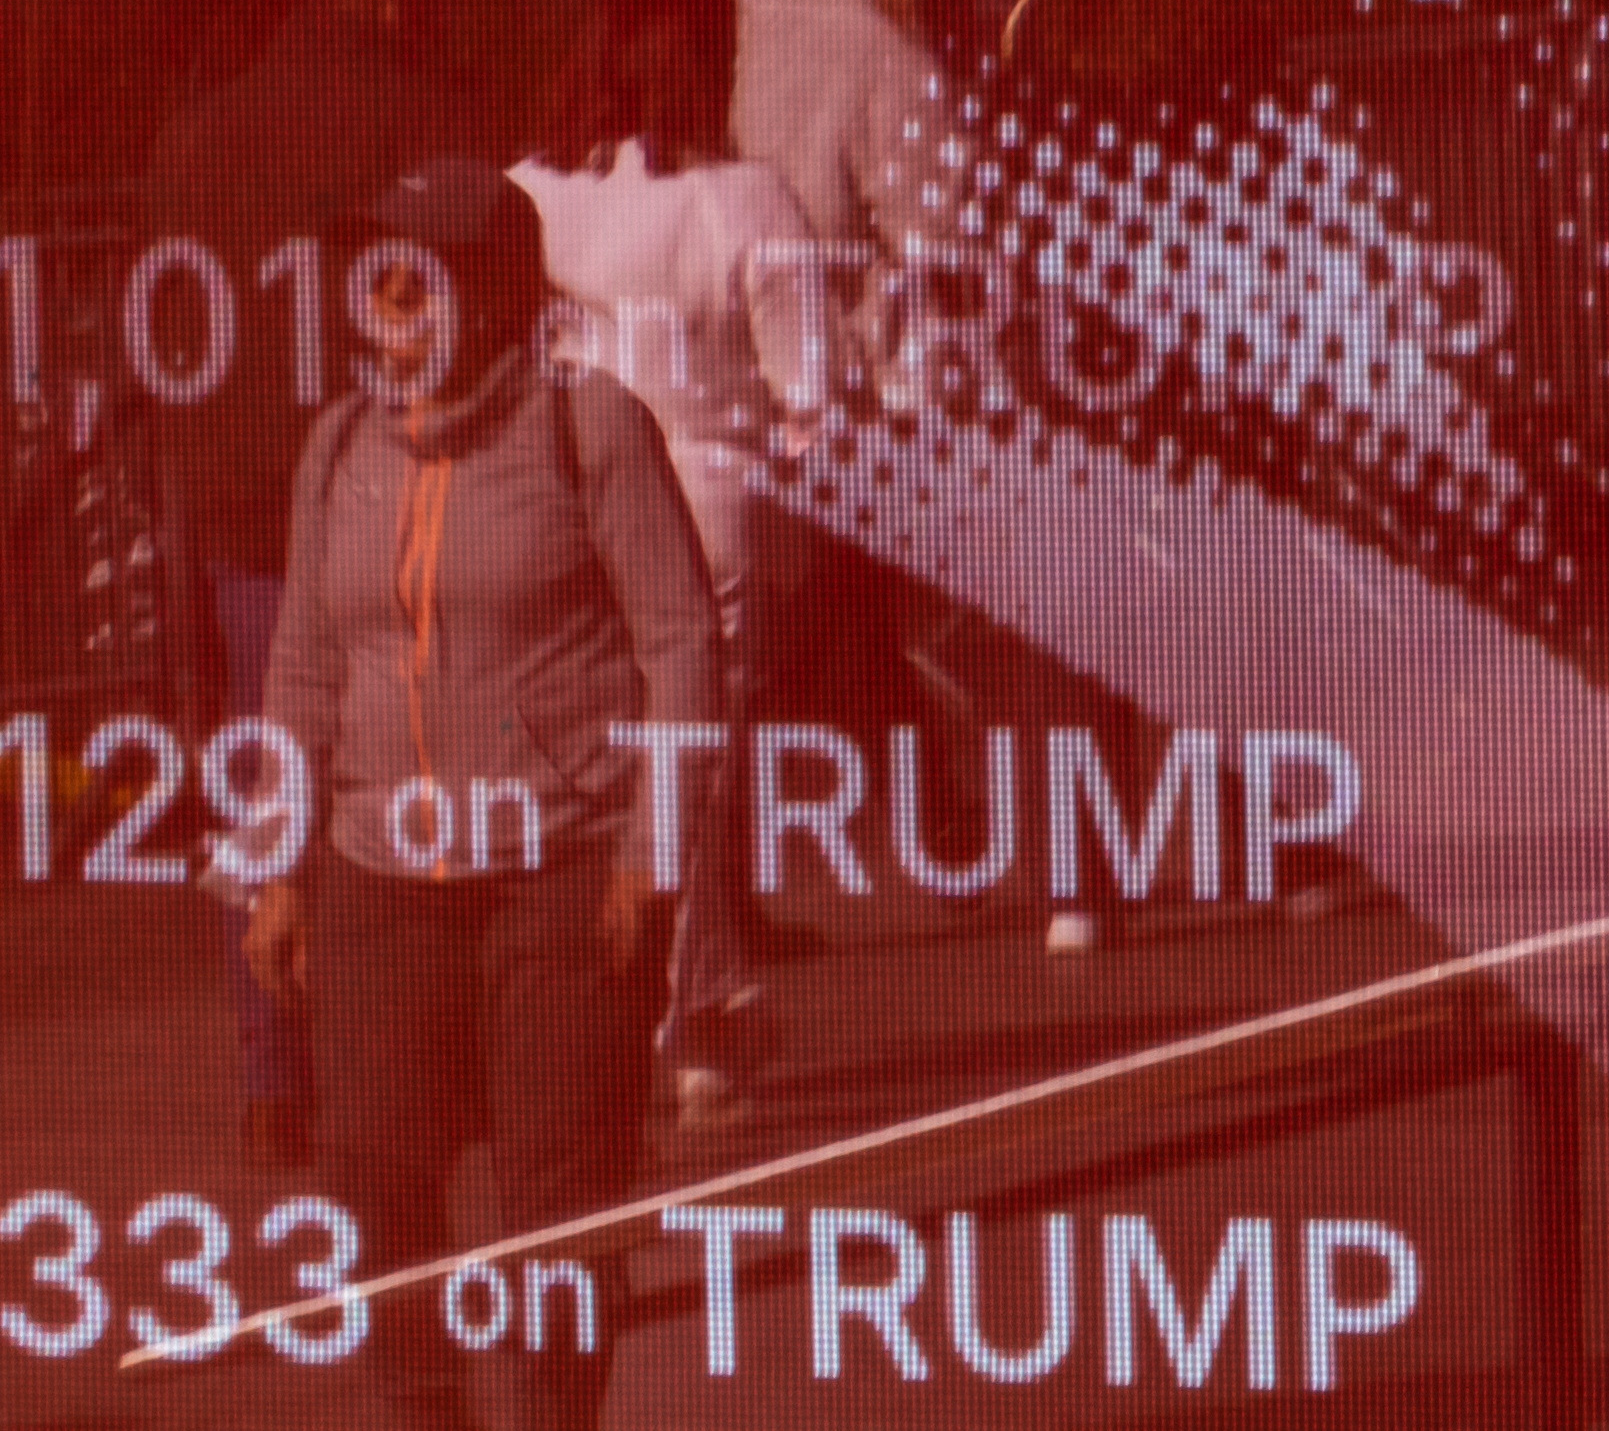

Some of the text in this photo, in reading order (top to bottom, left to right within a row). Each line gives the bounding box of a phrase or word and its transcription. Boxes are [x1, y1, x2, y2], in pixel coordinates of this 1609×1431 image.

[0, 712, 1362, 902] 129 on TRUMP
[0, 1188, 1424, 1392] 333 on TRUMP
